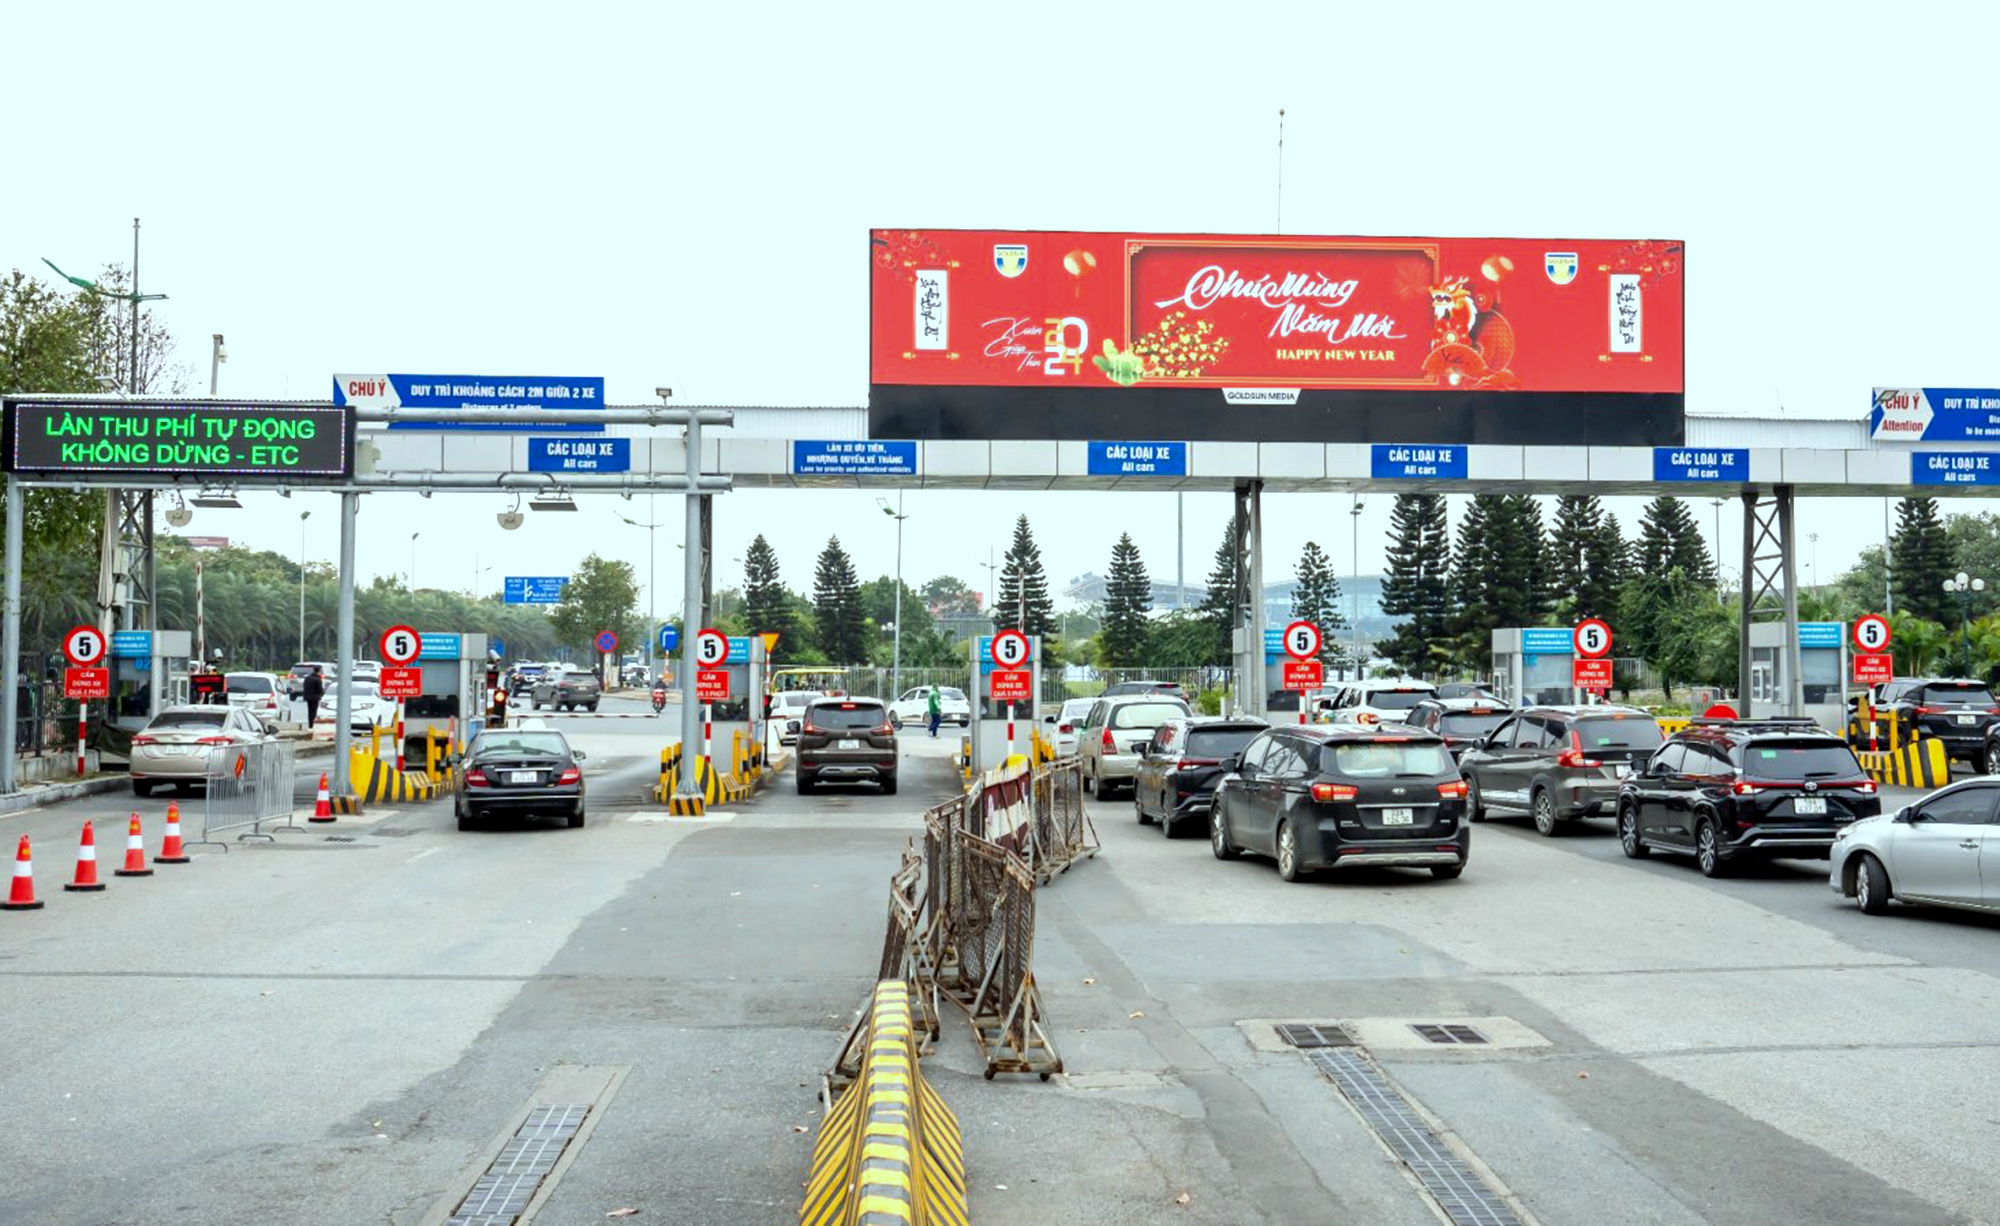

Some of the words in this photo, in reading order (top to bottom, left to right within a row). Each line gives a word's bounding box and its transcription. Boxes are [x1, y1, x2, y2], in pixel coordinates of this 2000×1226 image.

[1277, 349, 1320, 361] HAPPY
[1325, 350, 1356, 361] NEW
[1359, 350, 1396, 361] YEAR
[349, 381, 376, 397] CHÚ
[378, 380, 386, 396] Ý
[411, 385, 431, 397] DUY
[434, 382, 450, 397] TRÌ
[453, 384, 495, 398] KHOẢNG
[498, 384, 526, 398] CÁCH
[527, 386, 544, 398] 2M
[546, 384, 570, 399] GIỮA
[573, 387, 579, 399] 2
[582, 387, 596, 399] XE
[1227, 391, 1267, 400] GOLDSUN
[1268, 391, 1295, 401] MEDIA
[1884, 393, 1909, 410] CHÚ
[1913, 393, 1920, 410] Ý
[1944, 398, 1962, 409] DUY
[1965, 395, 1979, 409] TRÌ
[46, 412, 92, 436] LÀN
[100, 417, 149, 437] THU
[156, 413, 196, 437] PHÍ
[202, 417, 238, 442] TỰ
[243, 417, 315, 443] ĐỘNG
[1882, 419, 1923, 431] Attention
[62, 440, 149, 463] KHÔNG
[156, 440, 230, 465] DỪNG
[252, 446, 299, 465] ETC
[547, 441, 571, 455] CÁC
[574, 443, 596, 458] LOẠI
[599, 443, 613, 456] XE
[1106, 445, 1127, 459] CÁC
[1130, 446, 1153, 461] LOẠI
[1156, 447, 1170, 459] XE
[1389, 447, 1410, 462] CÁC
[1412, 450, 1435, 464] LOẠI
[1438, 450, 1452, 462] XE
[563, 458, 576, 468] All
[577, 459, 597, 468] cars
[1122, 462, 1134, 471] All
[1136, 463, 1155, 472] cars
[1671, 450, 1692, 465] CÁC
[1694, 453, 1717, 468] LOẠI
[1721, 453, 1734, 466] XE
[1929, 455, 1949, 469] CÁC
[1952, 457, 1974, 472] LOẠI
[1976, 457, 1990, 469] XE
[1404, 465, 1416, 474] All
[1418, 466, 1436, 474] cars
[1687, 468, 1699, 478] All
[1701, 469, 1719, 478] cars
[1945, 472, 1956, 481] All
[1957, 473, 1976, 481] cars
[1297, 631, 1308, 650] 5
[1587, 629, 1598, 648] 5
[1866, 625, 1877, 643] 5
[79, 637, 91, 657] 5
[395, 636, 407, 656] 5
[704, 639, 716, 659] 5
[1005, 640, 1016, 659] 5
